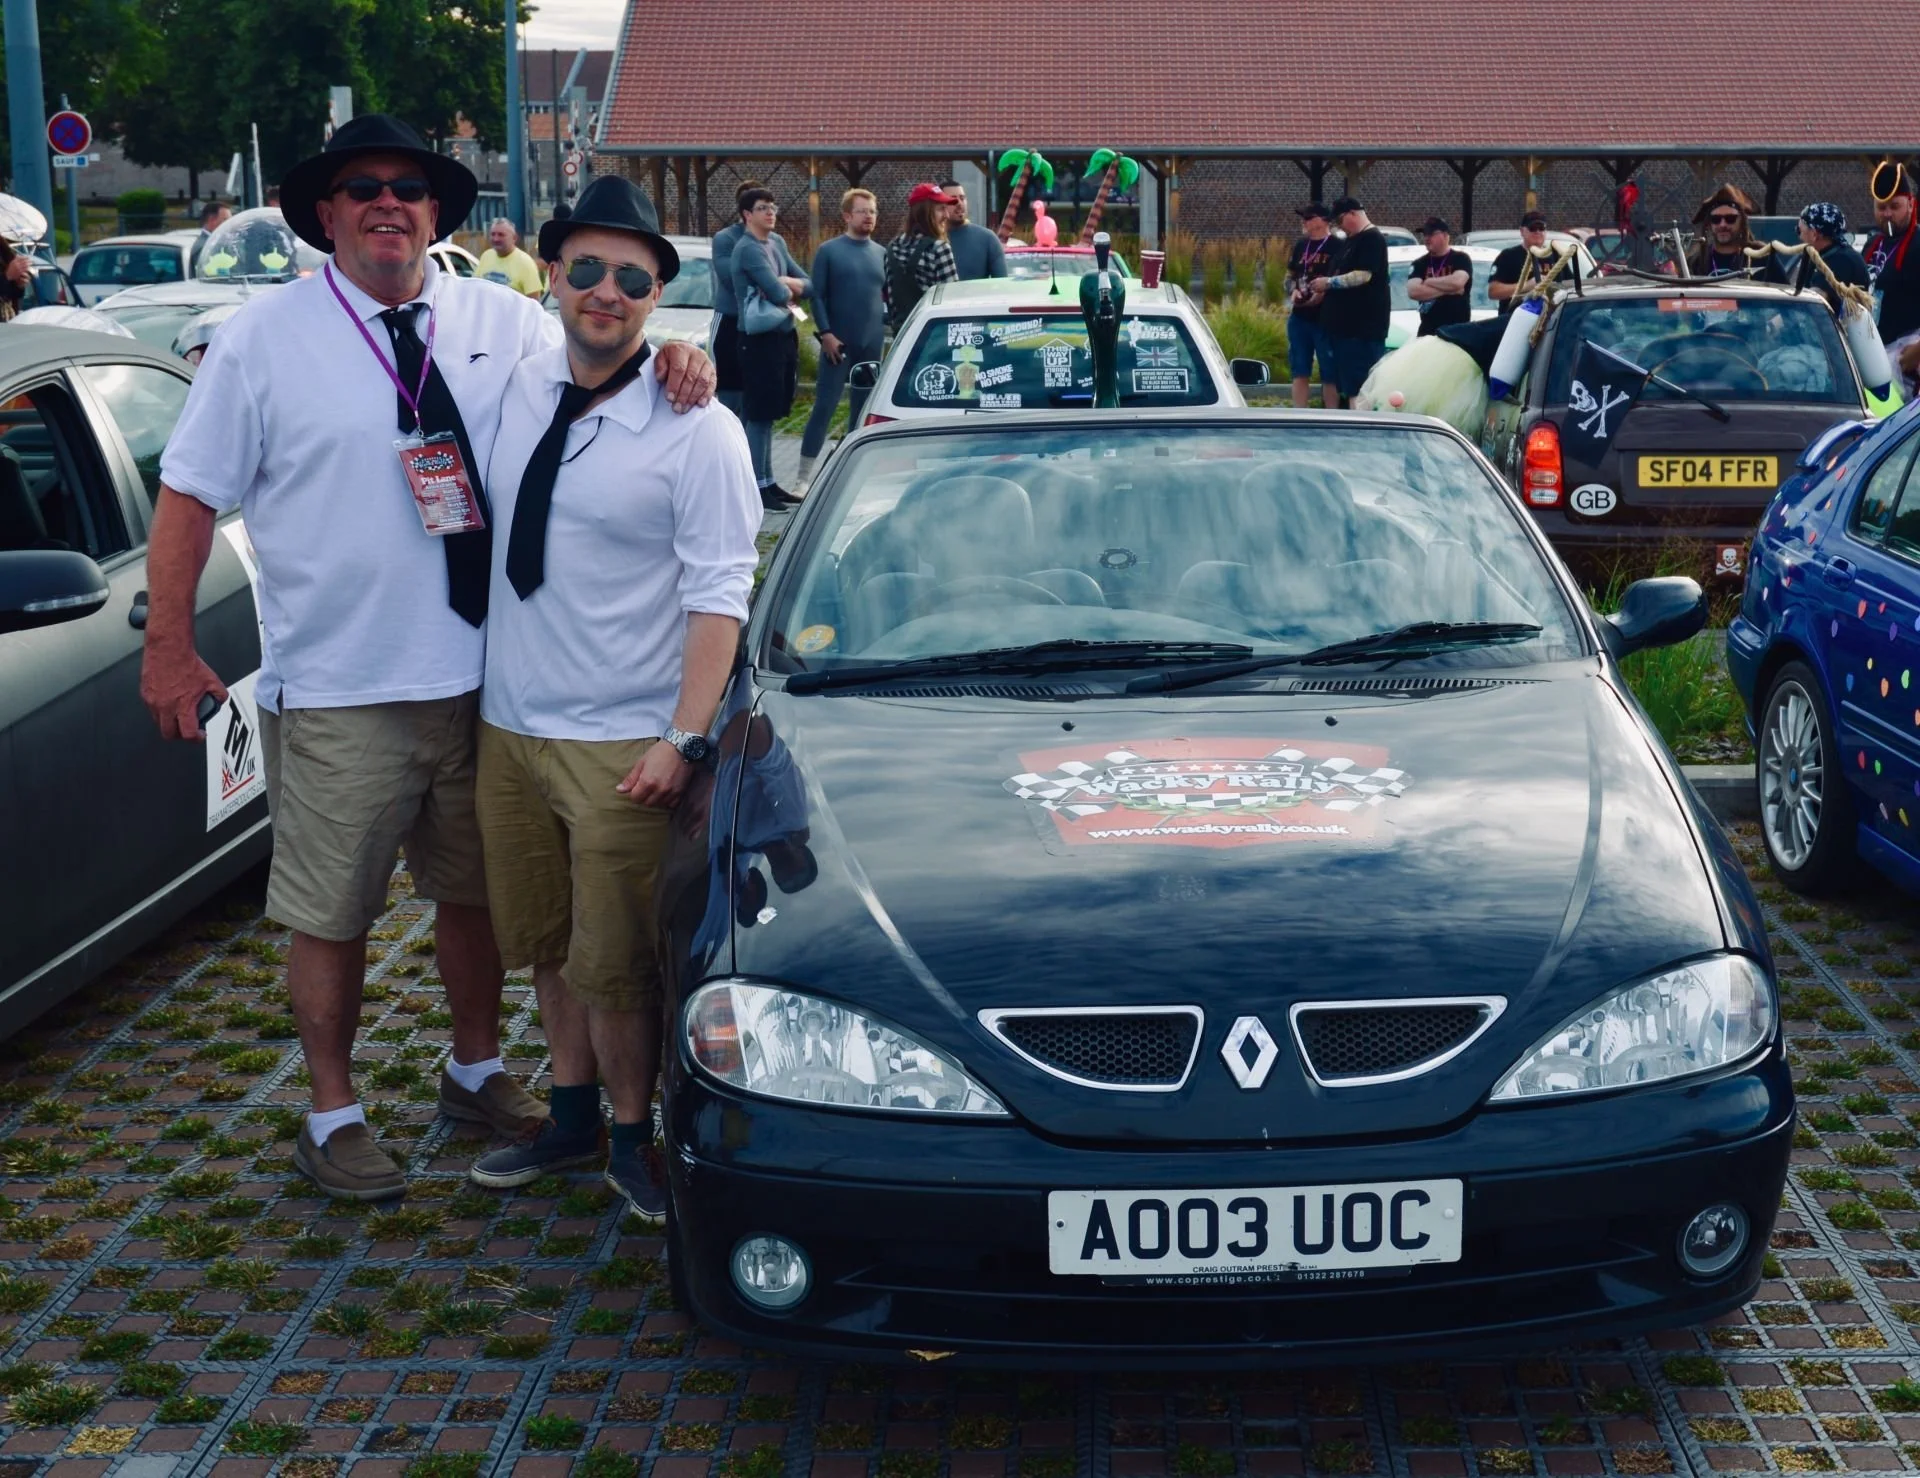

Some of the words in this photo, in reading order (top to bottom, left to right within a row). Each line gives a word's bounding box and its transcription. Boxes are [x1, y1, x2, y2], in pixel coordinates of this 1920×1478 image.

[989, 328, 1003, 338] GO
[1004, 318, 1043, 335] AROUND!
[1140, 331, 1177, 340] BOSS
[947, 335, 974, 346] FAT
[1046, 357, 1068, 366] UP
[975, 371, 986, 381] NO
[987, 364, 1013, 377] SMOKE
[980, 378, 992, 388] NO
[993, 372, 1013, 384] POKE
[1650, 460, 1713, 482] SF04
[1720, 460, 1768, 482] FFR
[421, 476, 435, 485] Pit
[435, 475, 457, 483] Lane
[1576, 490, 1611, 509] GB
[247, 756, 256, 776] UK
[1078, 773, 1218, 797] Wacky
[1226, 774, 1336, 795] Rally
[1088, 824, 1350, 839] www.wackyrally.co.uk
[1293, 1189, 1431, 1255] UOC
[1297, 1271, 1327, 1280] 01322
